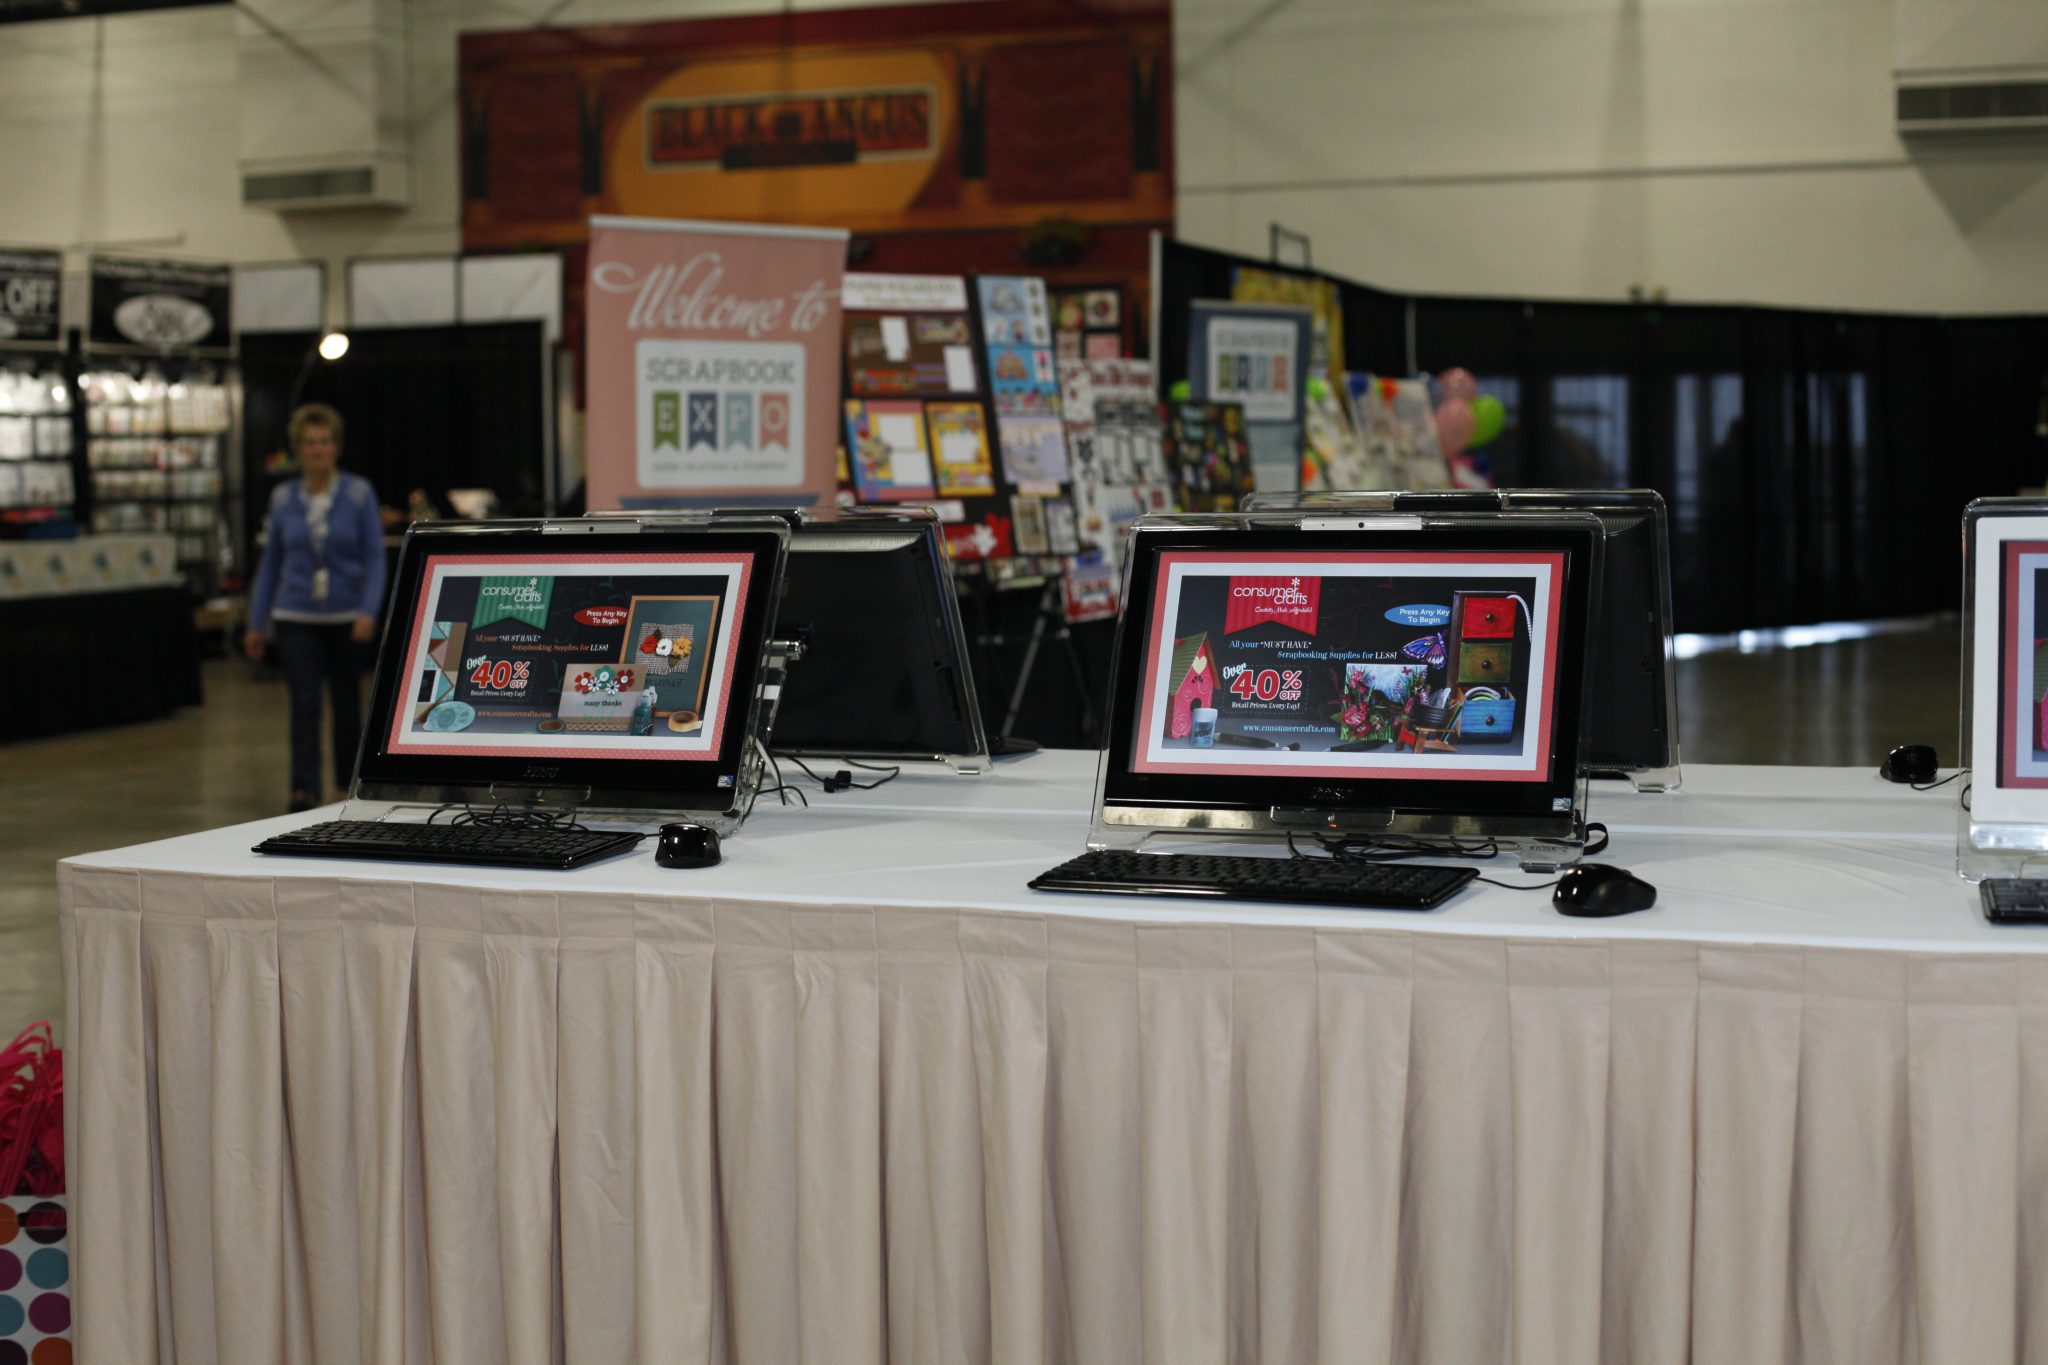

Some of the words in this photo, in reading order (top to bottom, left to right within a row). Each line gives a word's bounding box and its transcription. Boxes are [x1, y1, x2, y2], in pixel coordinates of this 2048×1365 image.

[592, 251, 785, 338] Welcome
[789, 280, 842, 332] to
[645, 357, 796, 385] SCRAPBOOK
[657, 401, 787, 433] EXPO
[482, 586, 536, 596] consumer
[1233, 587, 1299, 597] consumer
[514, 591, 542, 602] crafts
[1273, 592, 1308, 605] crafts
[1420, 608, 1435, 616] Any
[1436, 608, 1451, 617] Key
[602, 617, 619, 625] Begin
[1419, 616, 1441, 624] Begin
[1229, 640, 1240, 648] All
[1240, 641, 1259, 650] your
[1277, 650, 1328, 660] Scrapbooking
[1329, 651, 1360, 661] Supplies
[1362, 651, 1374, 659] for
[1375, 651, 1398, 660] LESS!
[466, 654, 487, 670] Over
[1222, 661, 1247, 680] Over
[509, 680, 528, 689] OFF
[1279, 690, 1302, 701] OFF
[1231, 701, 1249, 709] Retail
[1269, 702, 1286, 711] Every
[1286, 702, 1301, 711] Day!
[1243, 724, 1336, 733] www.consumercrafts.com
